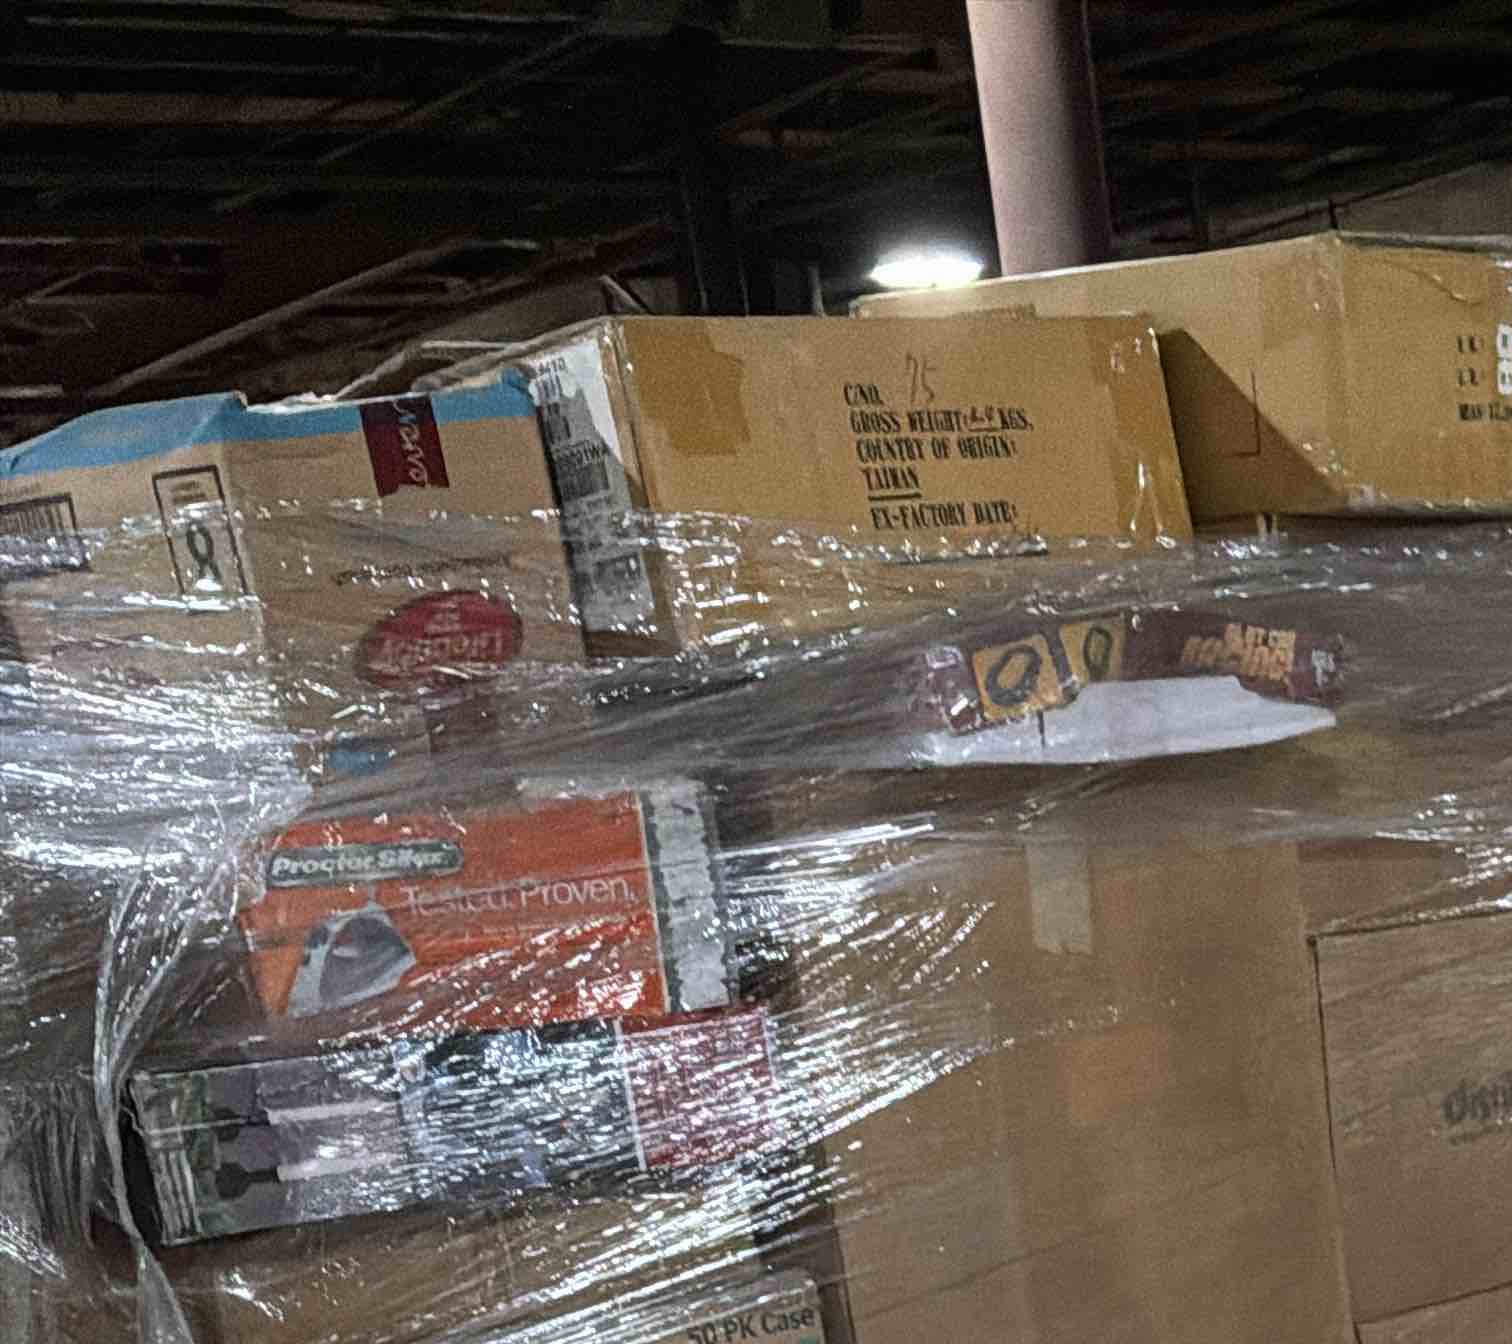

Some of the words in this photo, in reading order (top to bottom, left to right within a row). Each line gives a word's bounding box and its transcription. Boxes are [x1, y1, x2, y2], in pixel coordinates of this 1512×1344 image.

[849, 410, 900, 434] GROSS
[855, 437, 924, 464] COUNTRY
[931, 435, 950, 459] OF
[861, 465, 920, 491] TAIWAN
[870, 502, 966, 530] EX-FACTORY
[722, 1314, 758, 1343] PK
[761, 1307, 815, 1335] Case
